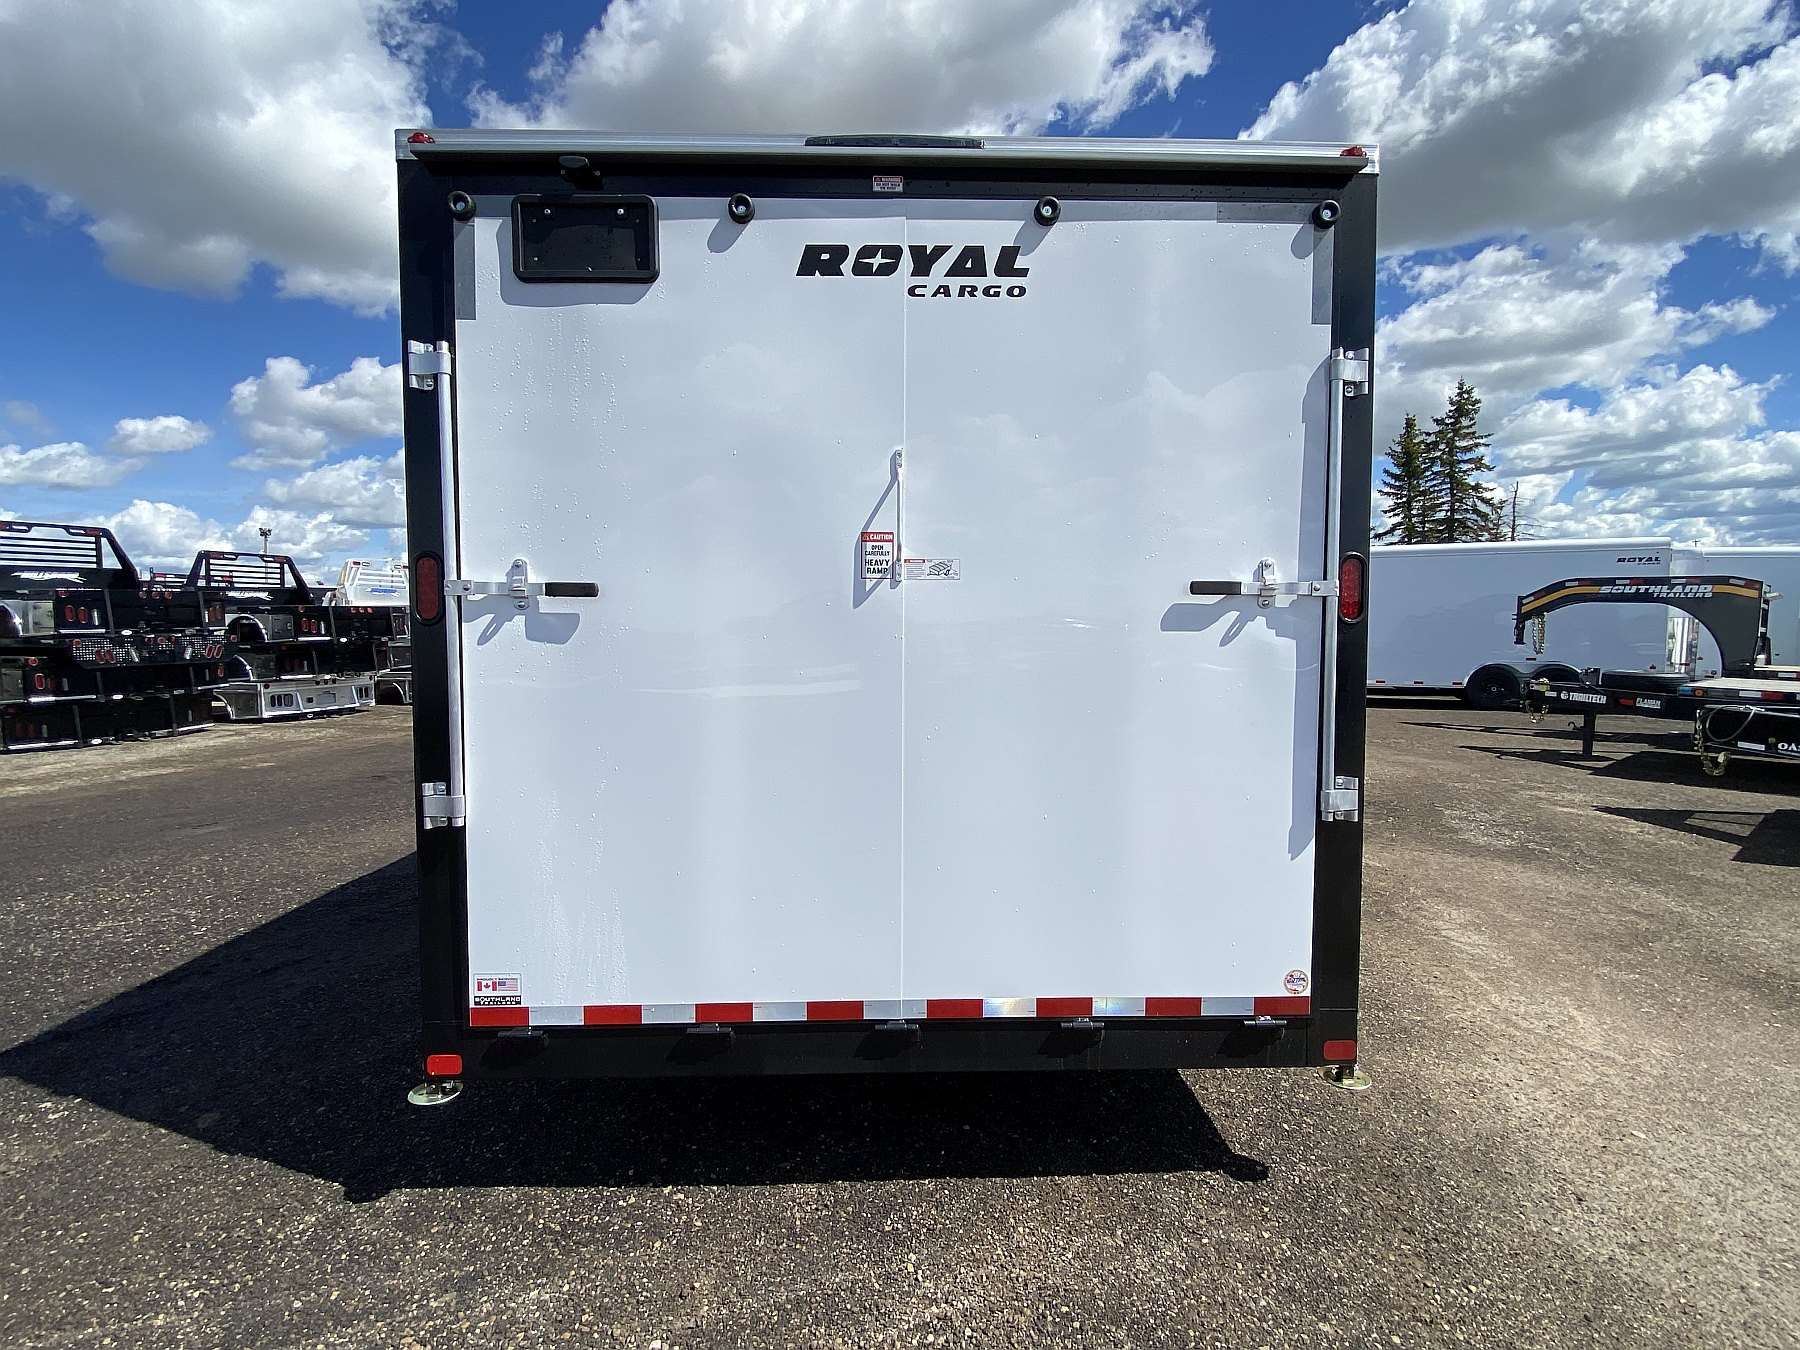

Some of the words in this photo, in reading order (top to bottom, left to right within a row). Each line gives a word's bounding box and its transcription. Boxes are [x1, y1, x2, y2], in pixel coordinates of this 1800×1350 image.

[796, 244, 1030, 277] ROYAL
[908, 285, 1027, 298] CARGO
[865, 559, 890, 567] HEAVY
[867, 567, 889, 575] RAMP
[1600, 585, 1713, 594] SOUTHLAND
[1569, 692, 1607, 704] TRAILTECH
